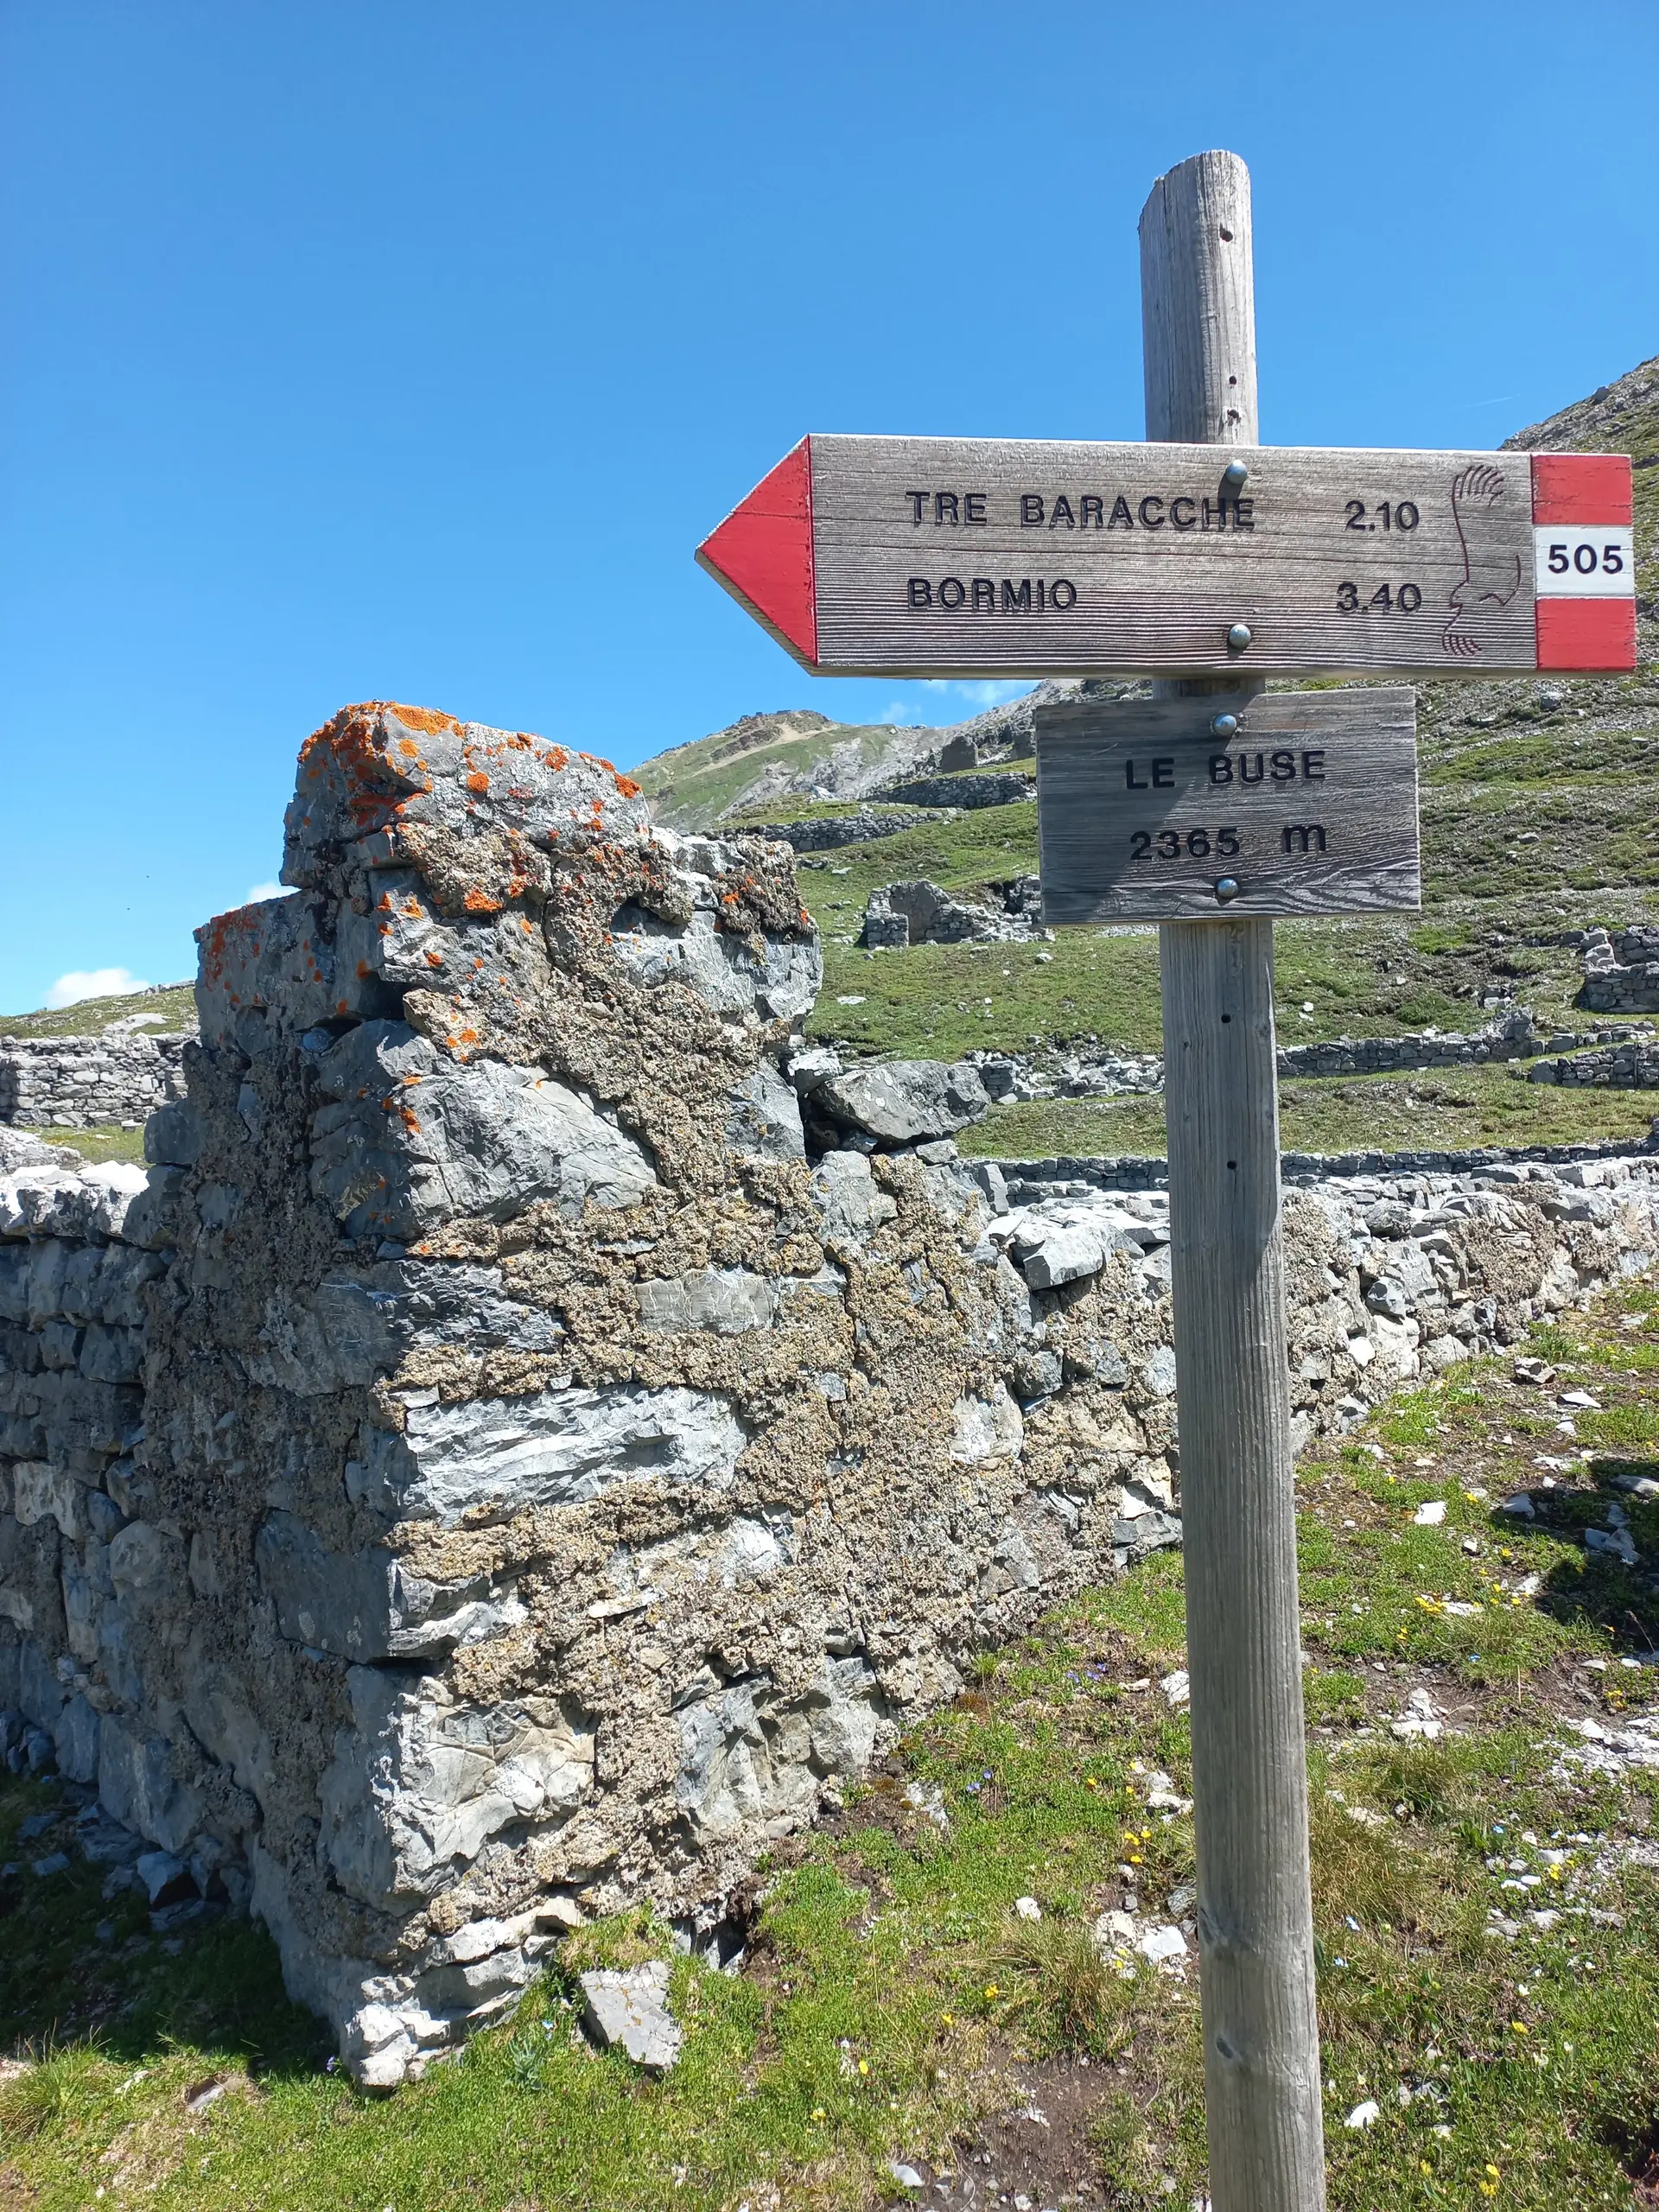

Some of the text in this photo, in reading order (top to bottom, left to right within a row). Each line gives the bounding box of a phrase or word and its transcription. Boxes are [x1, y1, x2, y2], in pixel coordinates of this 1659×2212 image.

[906, 491, 1420, 532] TRE BARACCHE 2.10
[1548, 544, 1624, 574] 505
[907, 577, 1422, 613] BORMIO 3.40
[1126, 750, 1326, 790] LE BUSE
[1130, 824, 1326, 861] 2365 m
